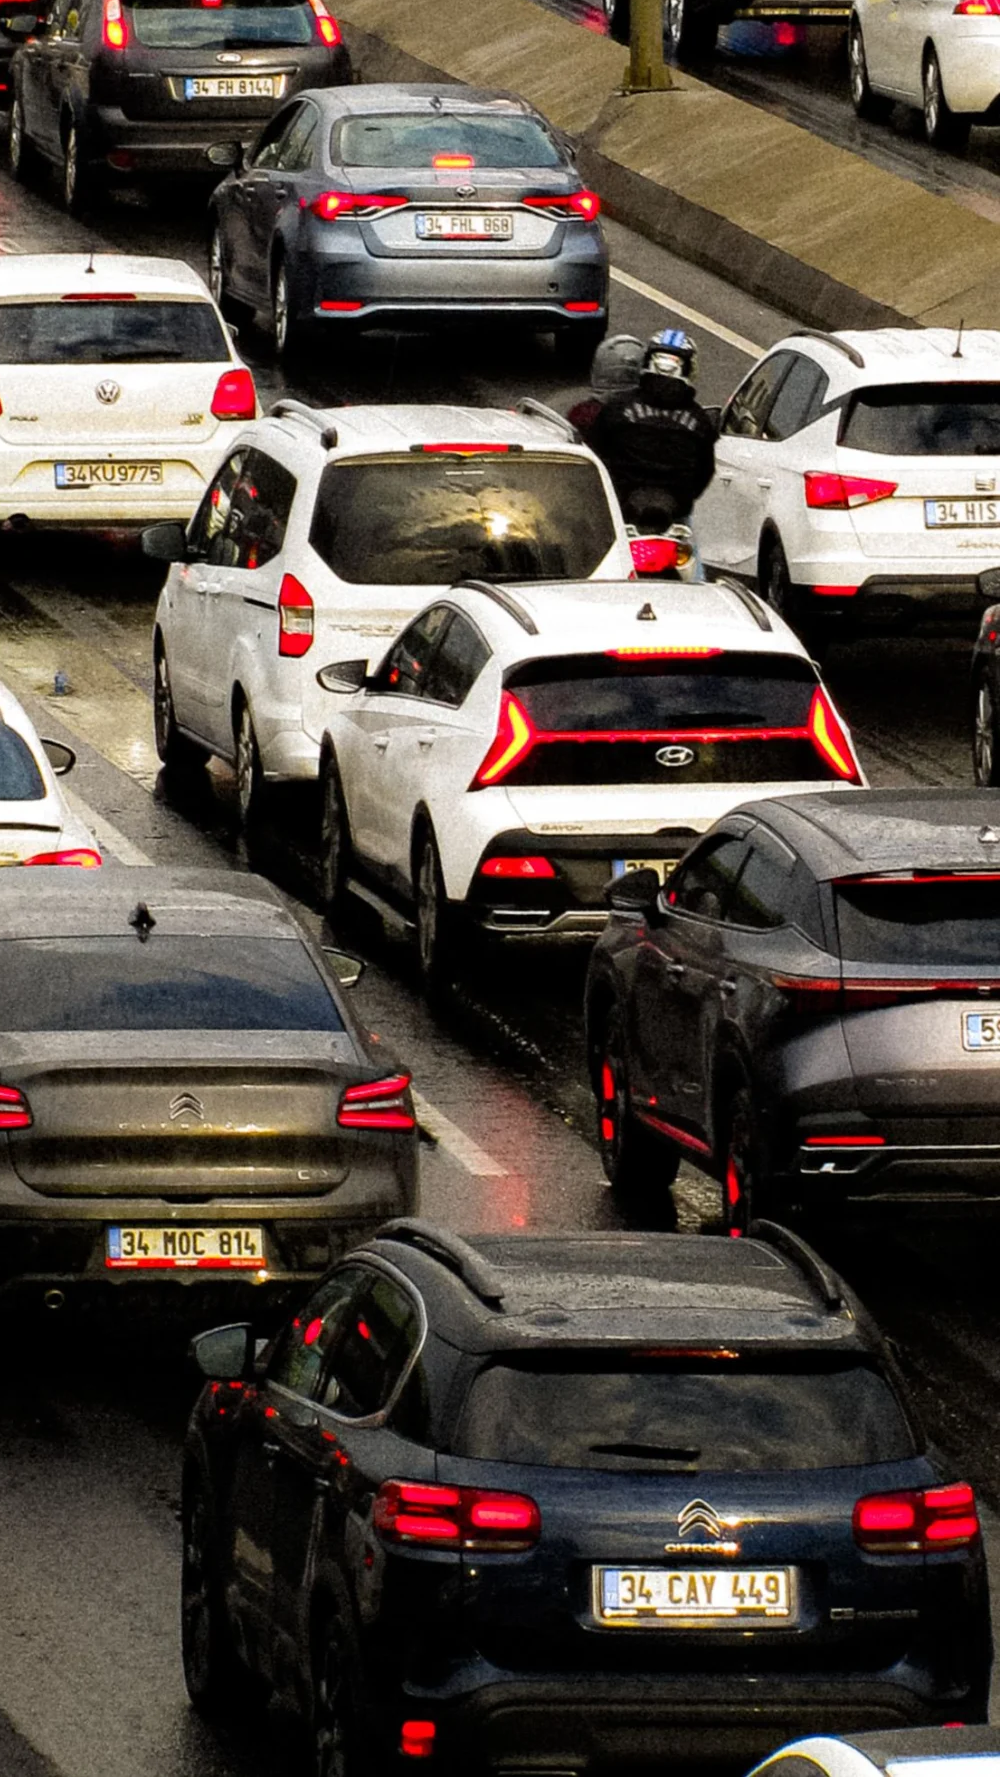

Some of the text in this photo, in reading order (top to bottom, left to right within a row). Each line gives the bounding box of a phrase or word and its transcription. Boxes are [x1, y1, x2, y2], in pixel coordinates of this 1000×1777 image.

[194, 80, 272, 95] 34 FH 8144
[426, 216, 444, 232] 34
[451, 216, 477, 233] FHL
[938, 503, 998, 522] 34 HIS
[121, 1229, 258, 1257] 34 MOC 814
[620, 1574, 780, 1605] 34 CAY 449
